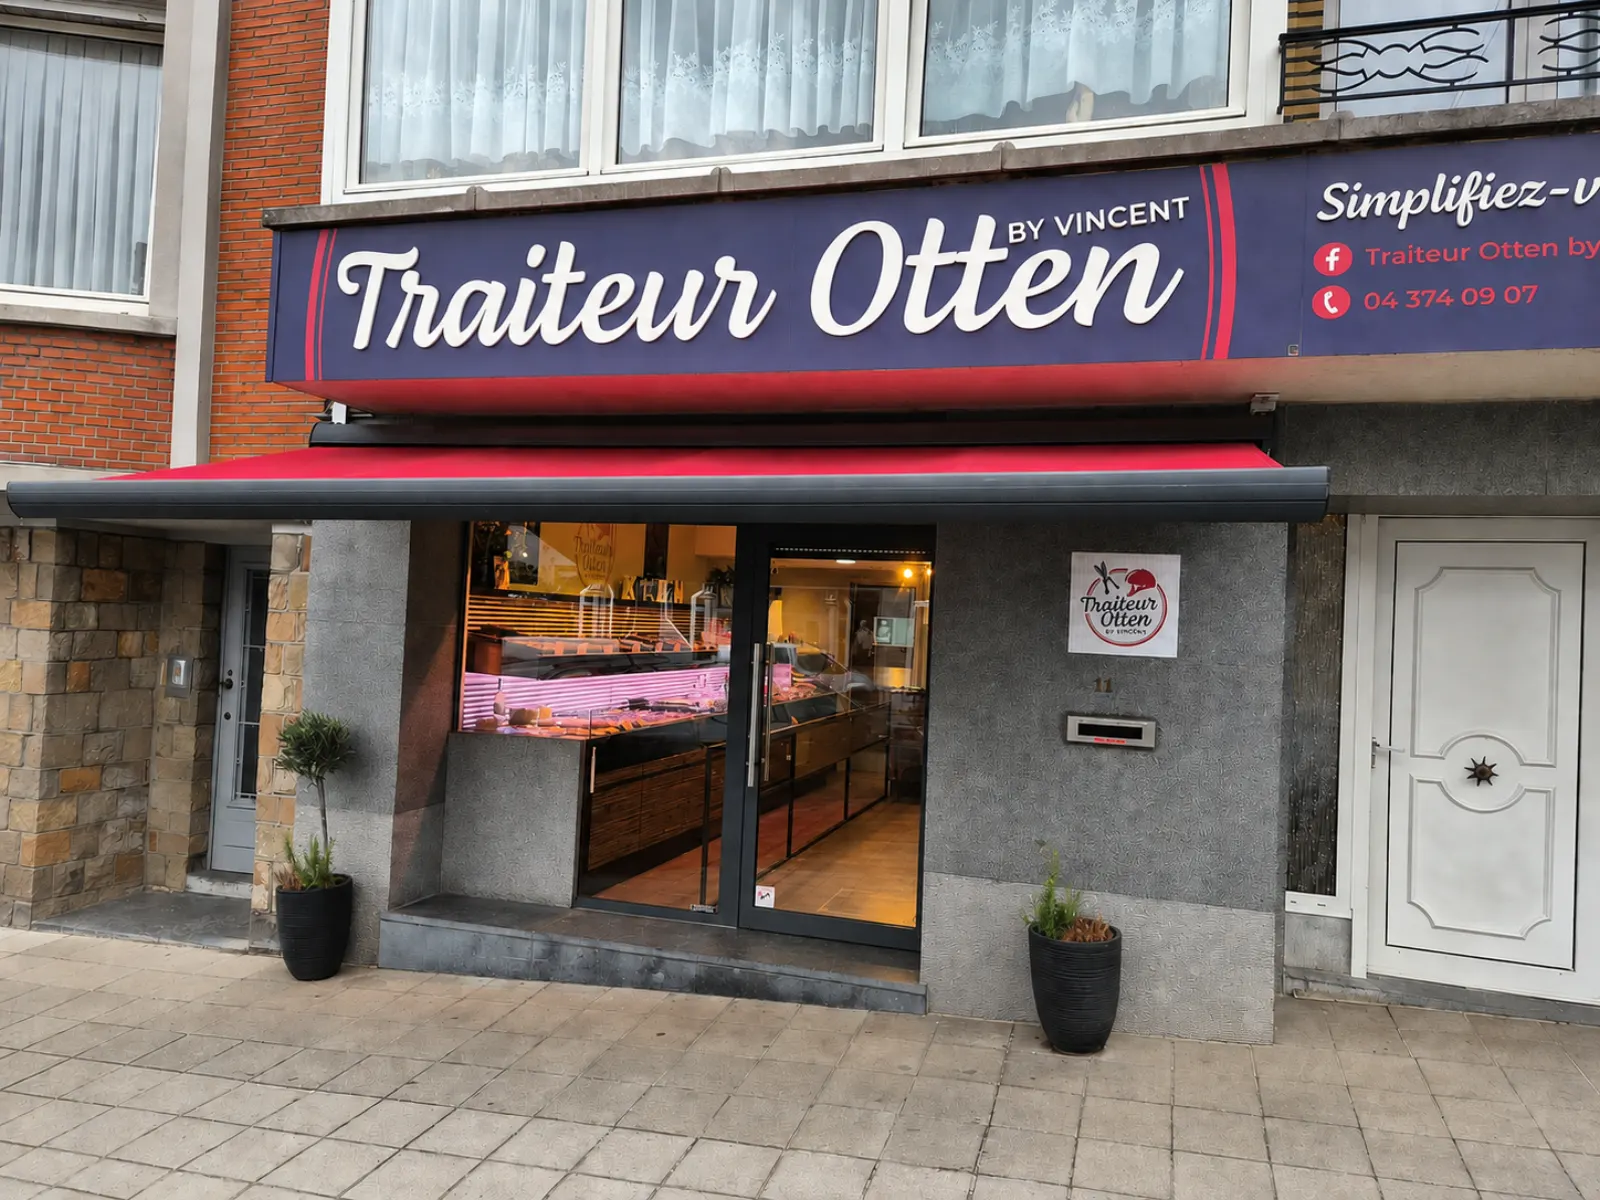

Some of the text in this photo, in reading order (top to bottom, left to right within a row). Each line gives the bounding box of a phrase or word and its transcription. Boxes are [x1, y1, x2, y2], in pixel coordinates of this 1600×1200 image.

[1008, 196, 1190, 244] BY VINCENT
[1365, 235, 1600, 268] Traiteur Otten by
[337, 214, 1185, 350] Traiteur Otten
[1363, 284, 1539, 311] 04 374 09 07
[1080, 595, 1158, 613] Traiteur
[1100, 610, 1152, 628] Otten
[1093, 676, 1113, 693] 11
